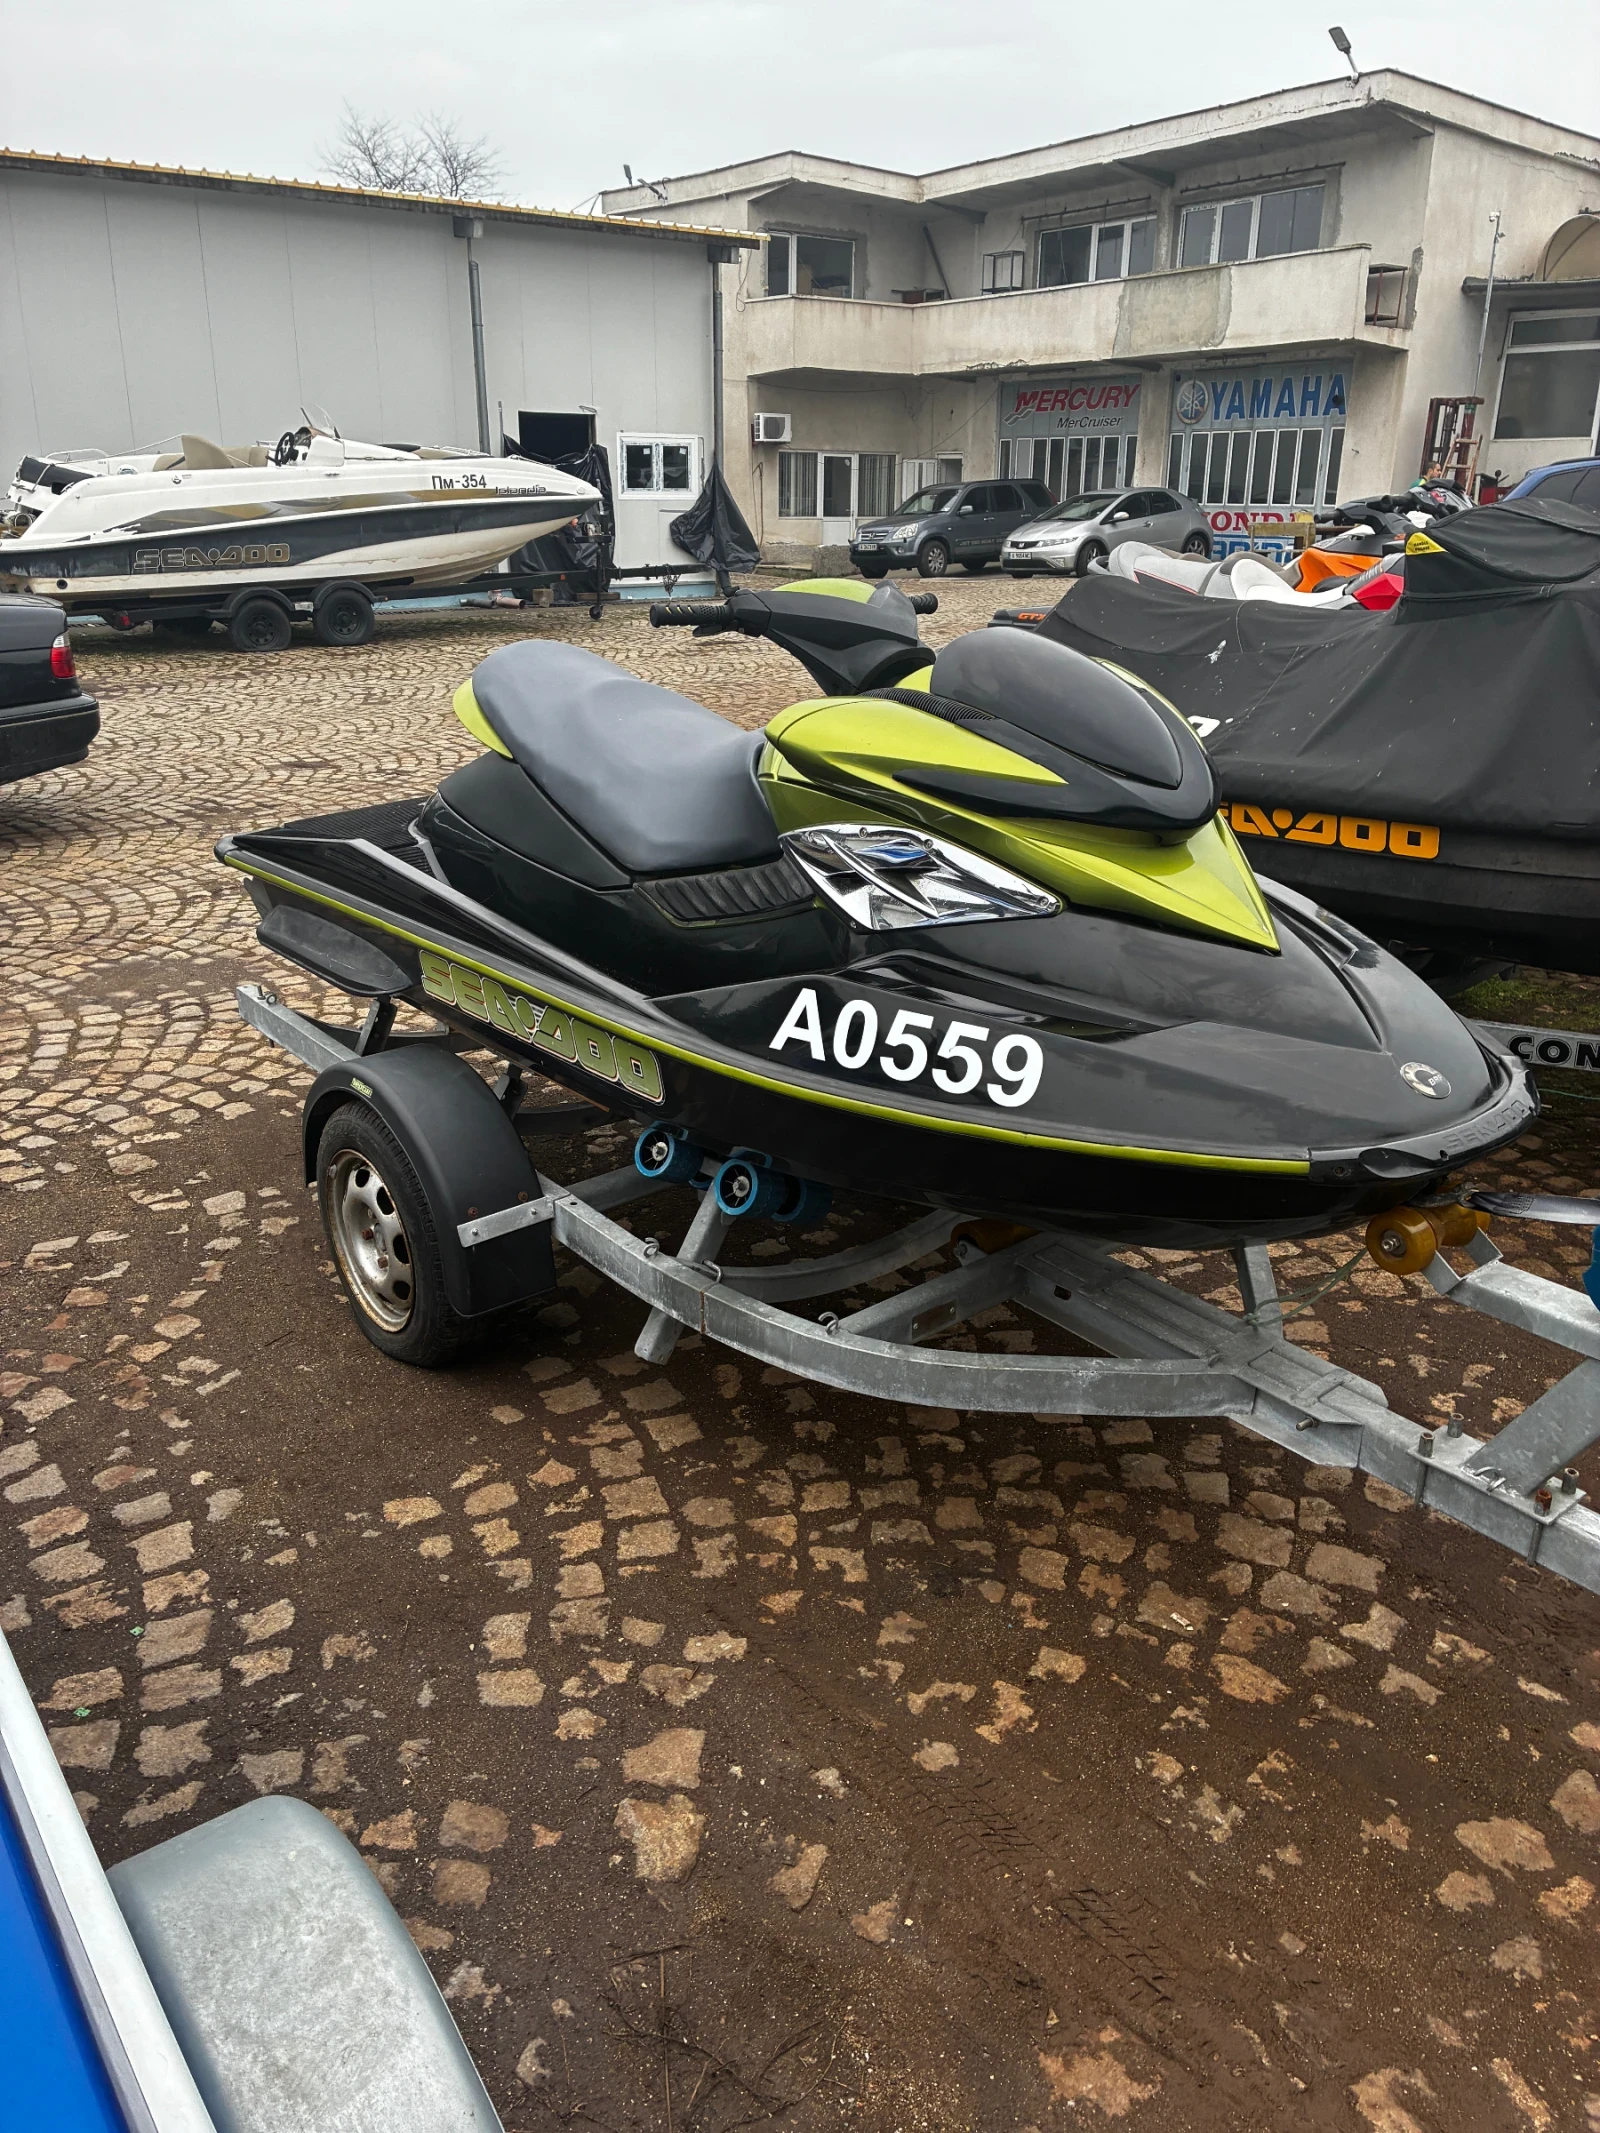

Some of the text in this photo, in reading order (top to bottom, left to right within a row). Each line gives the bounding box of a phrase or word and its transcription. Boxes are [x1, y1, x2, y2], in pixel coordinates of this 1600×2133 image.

[1014, 384, 1141, 413] MERCURY
[1210, 373, 1347, 421] YAMAHA
[1056, 416, 1123, 428] MerCruiser
[769, 988, 1044, 1107] A0559
